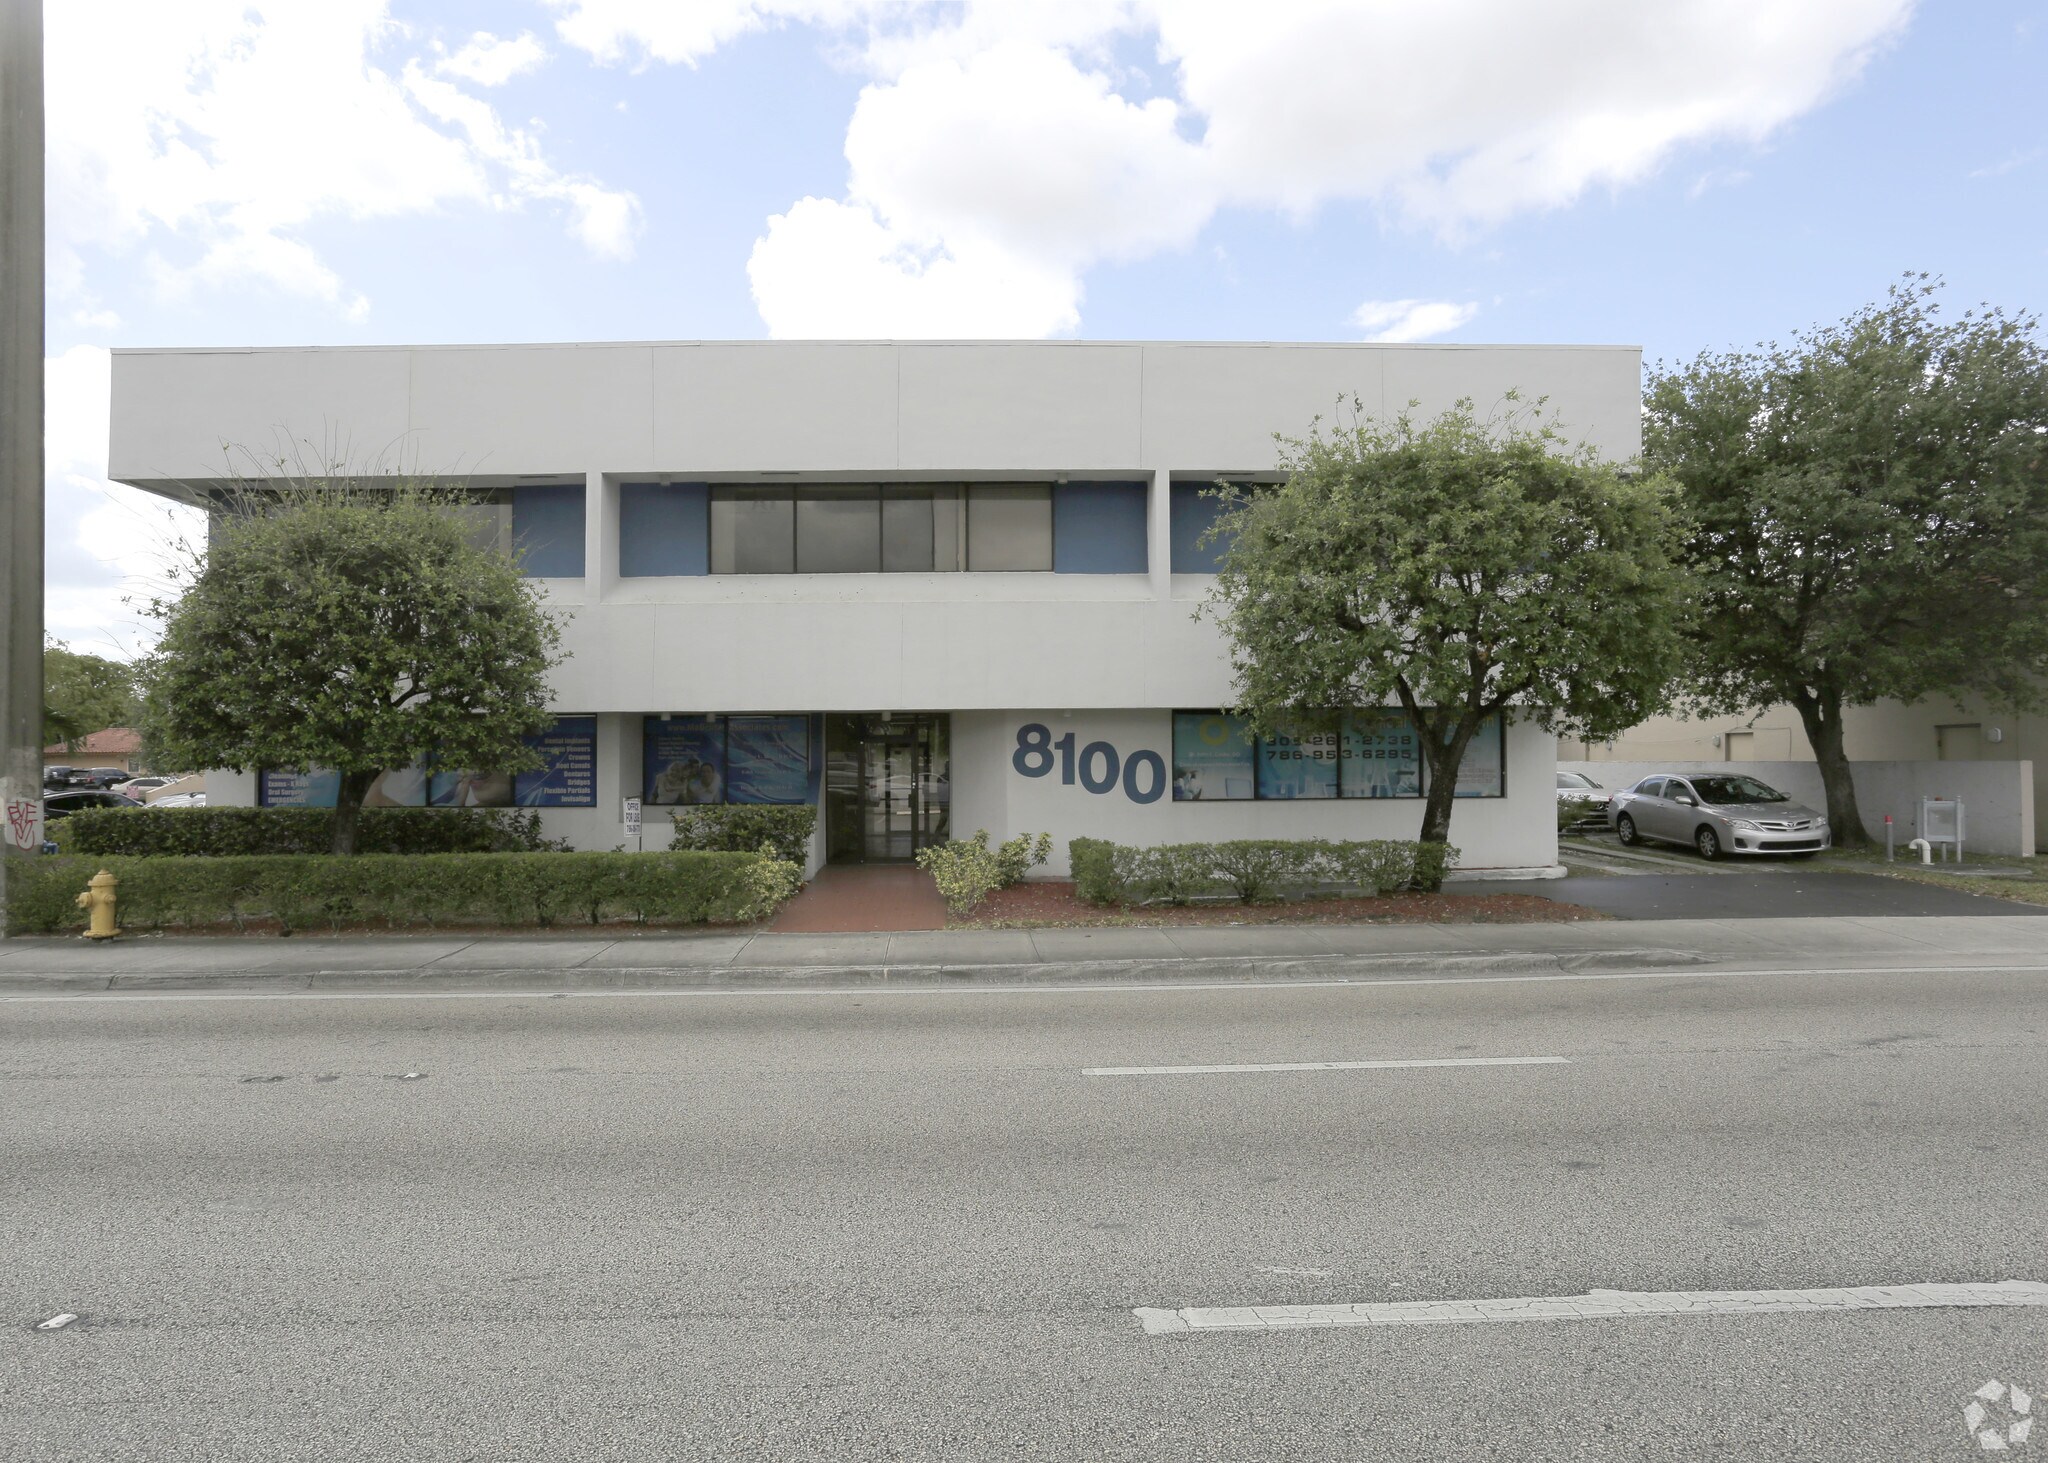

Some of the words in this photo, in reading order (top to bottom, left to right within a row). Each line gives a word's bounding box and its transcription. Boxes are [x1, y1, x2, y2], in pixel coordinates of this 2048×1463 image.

[565, 738, 591, 746] Implants
[1266, 749, 1412, 761] 786-953-6295
[1012, 722, 1166, 805] 8100
[567, 779, 591, 787] Bridges
[281, 789, 302, 797] Surgery
